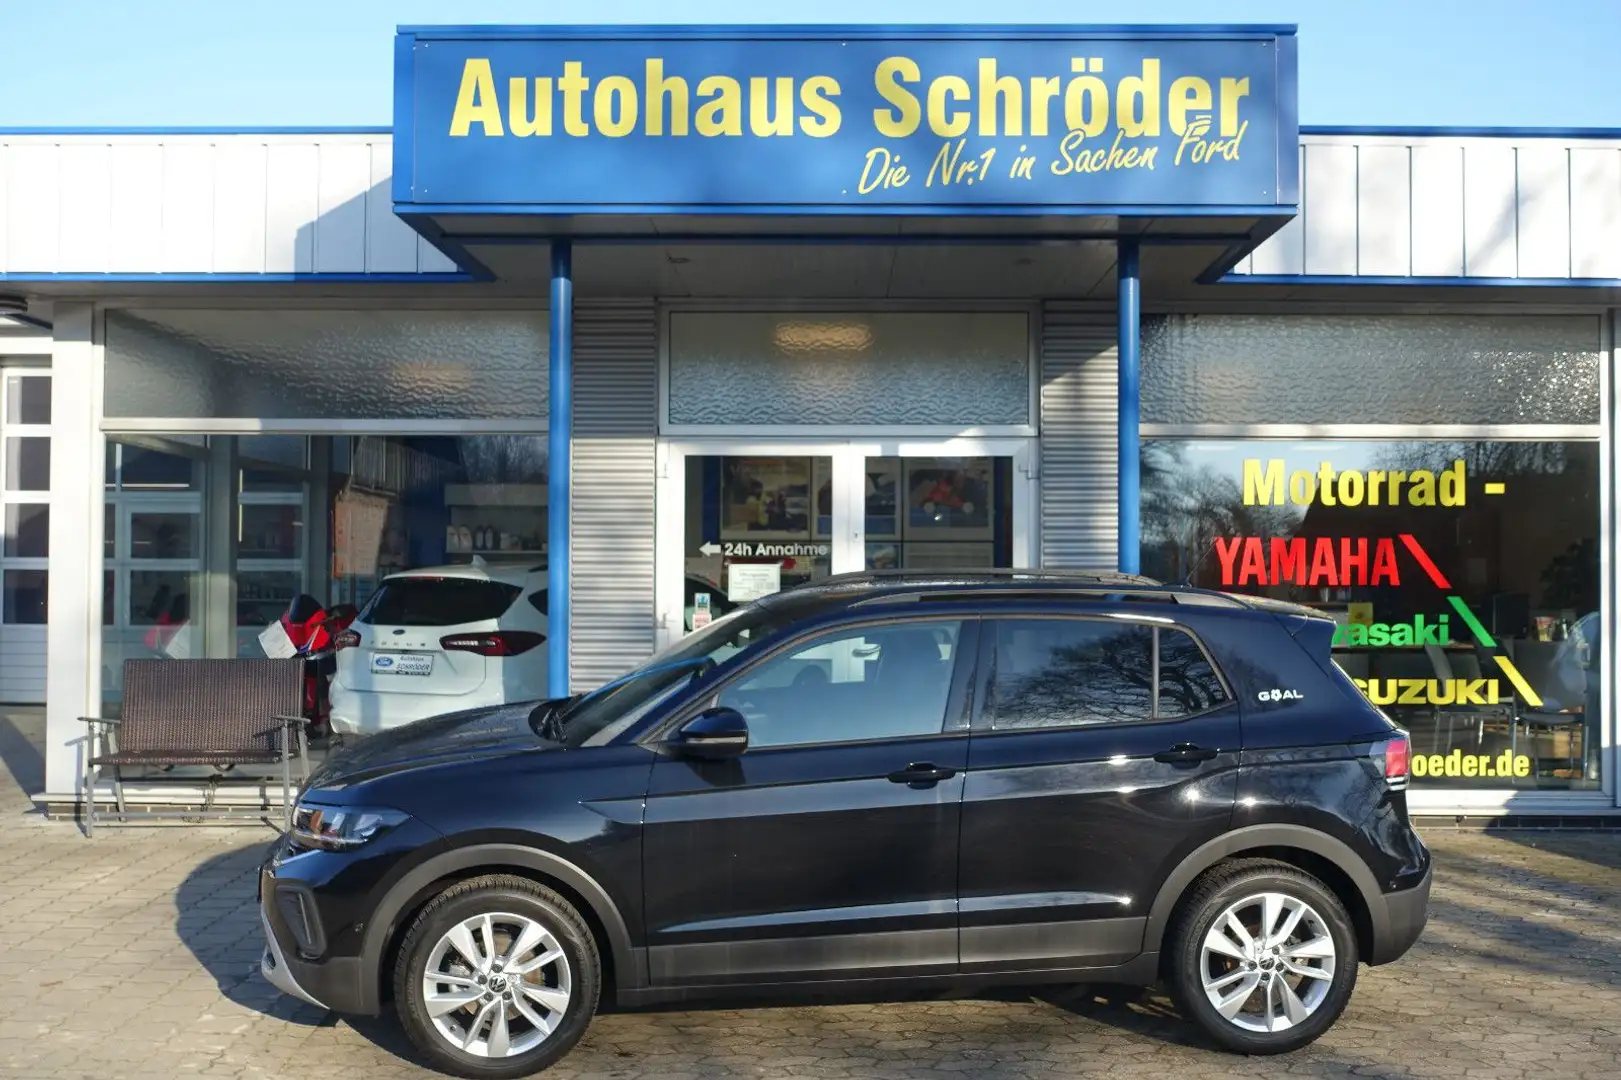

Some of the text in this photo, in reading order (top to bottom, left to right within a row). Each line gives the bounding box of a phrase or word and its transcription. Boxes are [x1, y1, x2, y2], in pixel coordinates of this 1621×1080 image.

[449, 56, 1249, 138] Autohaus Schröder
[858, 115, 1248, 194] Die Nr.1 in Sachen Ford
[1242, 458, 1467, 507] Motorrad
[724, 542, 828, 556] 24h Annahme
[1214, 536, 1401, 587] YAMAHA
